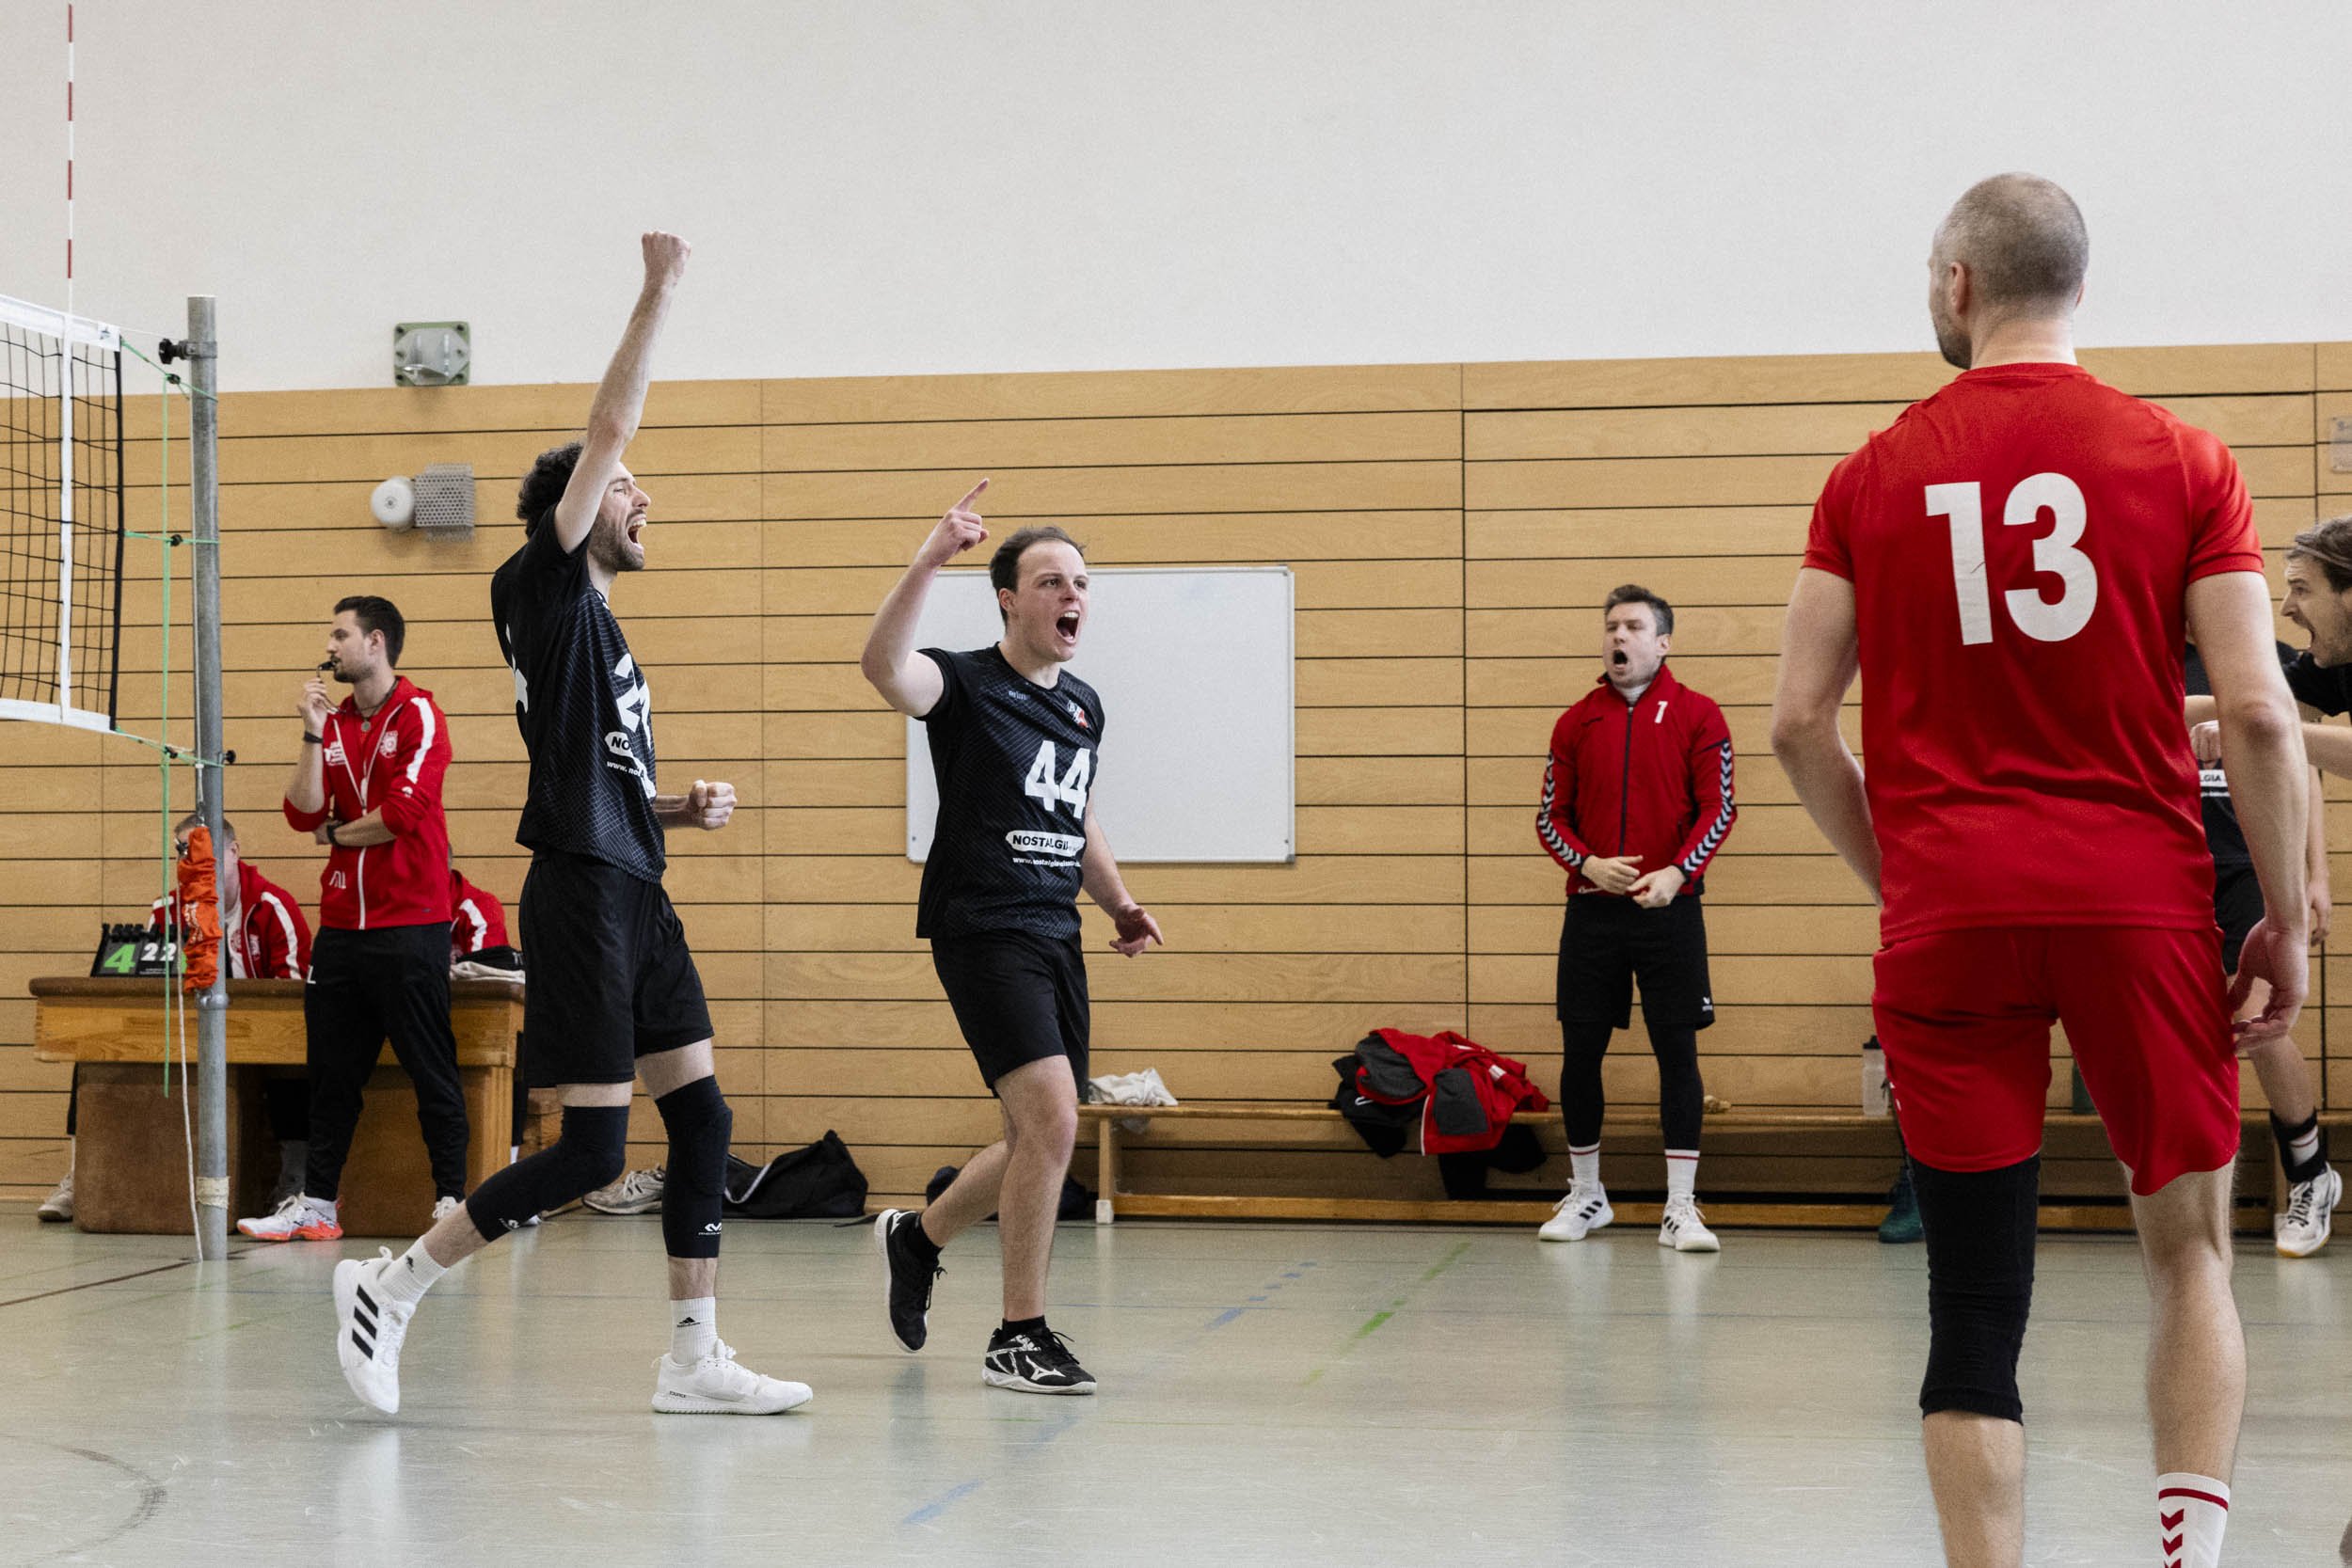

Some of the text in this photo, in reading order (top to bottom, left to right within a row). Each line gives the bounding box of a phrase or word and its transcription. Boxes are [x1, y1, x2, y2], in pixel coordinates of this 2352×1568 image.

[1925, 472, 2098, 646] 13
[1025, 739, 1091, 819] 44
[103, 943, 136, 974] 4
